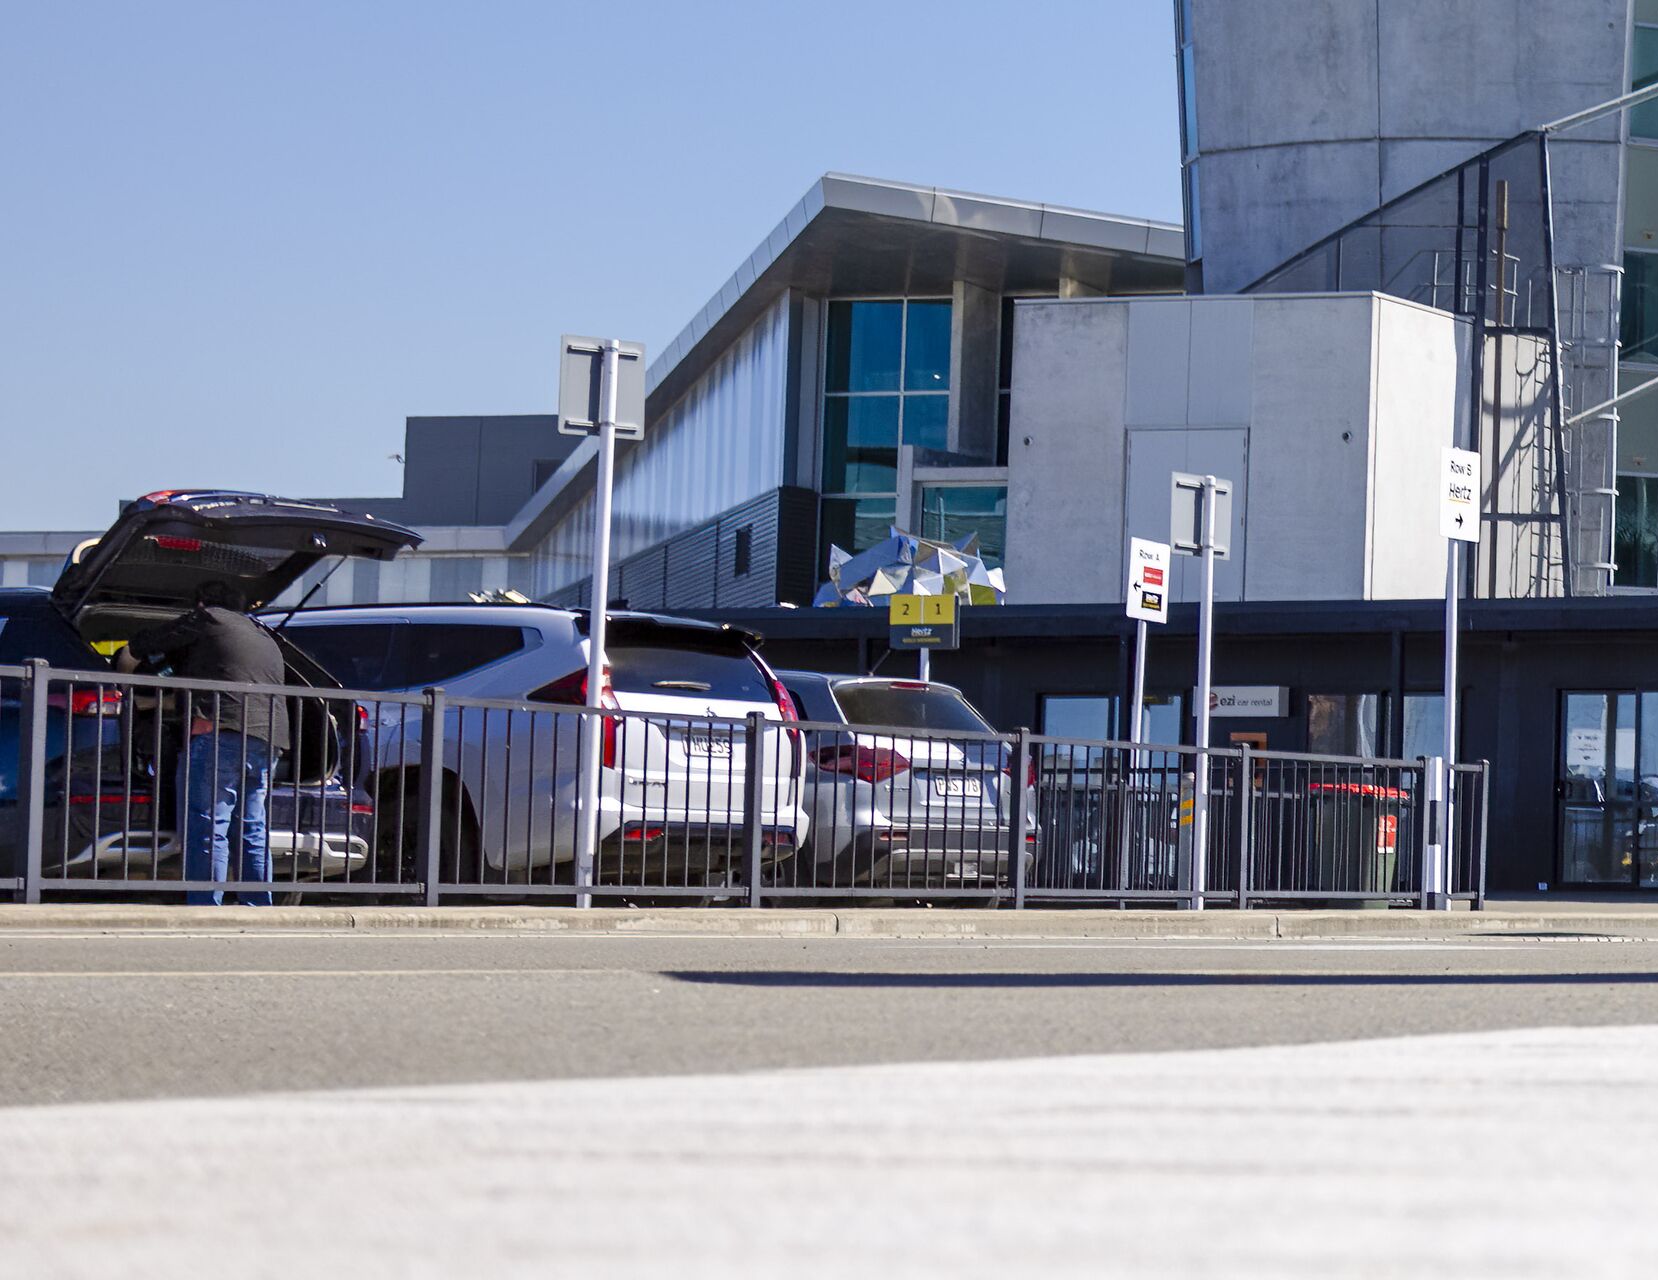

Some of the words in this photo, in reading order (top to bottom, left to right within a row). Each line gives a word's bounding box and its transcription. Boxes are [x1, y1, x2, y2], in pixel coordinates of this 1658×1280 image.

[1449, 482, 1472, 501] Hertz
[902, 602, 911, 616] 2
[935, 602, 942, 616] 1
[1219, 695, 1236, 706] ezi
[1250, 698, 1273, 706] rental
